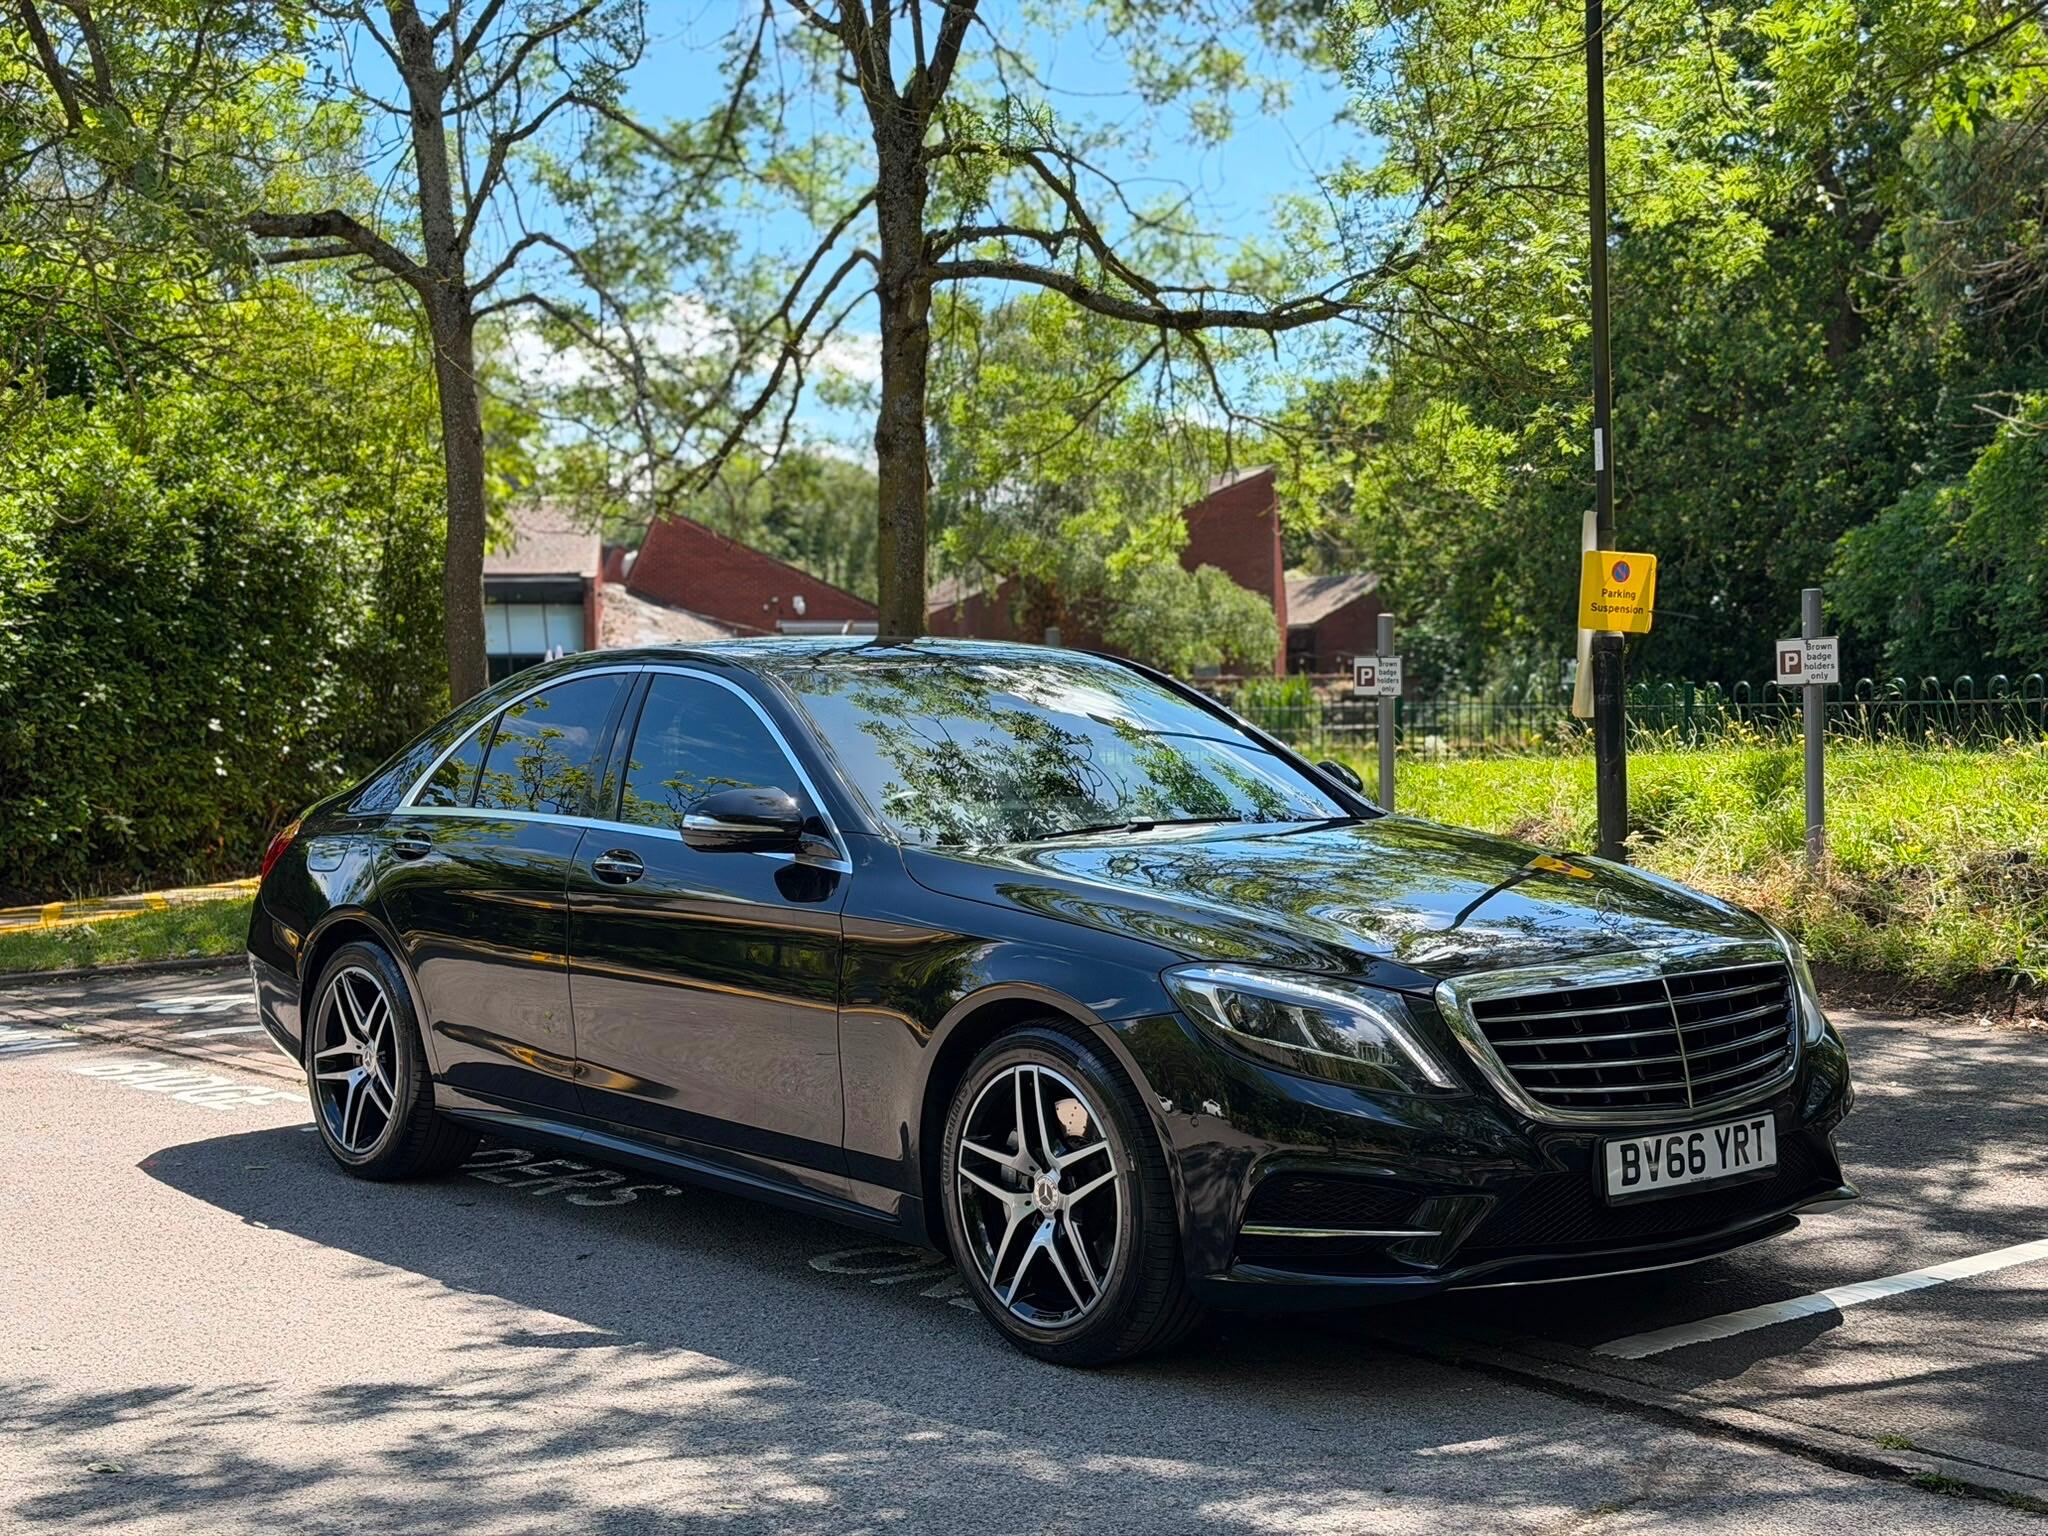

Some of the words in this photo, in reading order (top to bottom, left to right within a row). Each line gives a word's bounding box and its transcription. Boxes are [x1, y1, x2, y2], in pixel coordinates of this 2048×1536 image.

[1601, 588, 1636, 600] Parking
[1590, 602, 1643, 614] Suspension
[1806, 643, 1832, 651] Brown
[1806, 652, 1832, 661] badge
[1785, 653, 1799, 673] P
[1804, 662, 1835, 670] holders
[1360, 668, 1373, 686] P
[1810, 672, 1829, 680] only
[1620, 1132, 1706, 1186] BV66
[1714, 1119, 1765, 1169] YRT
